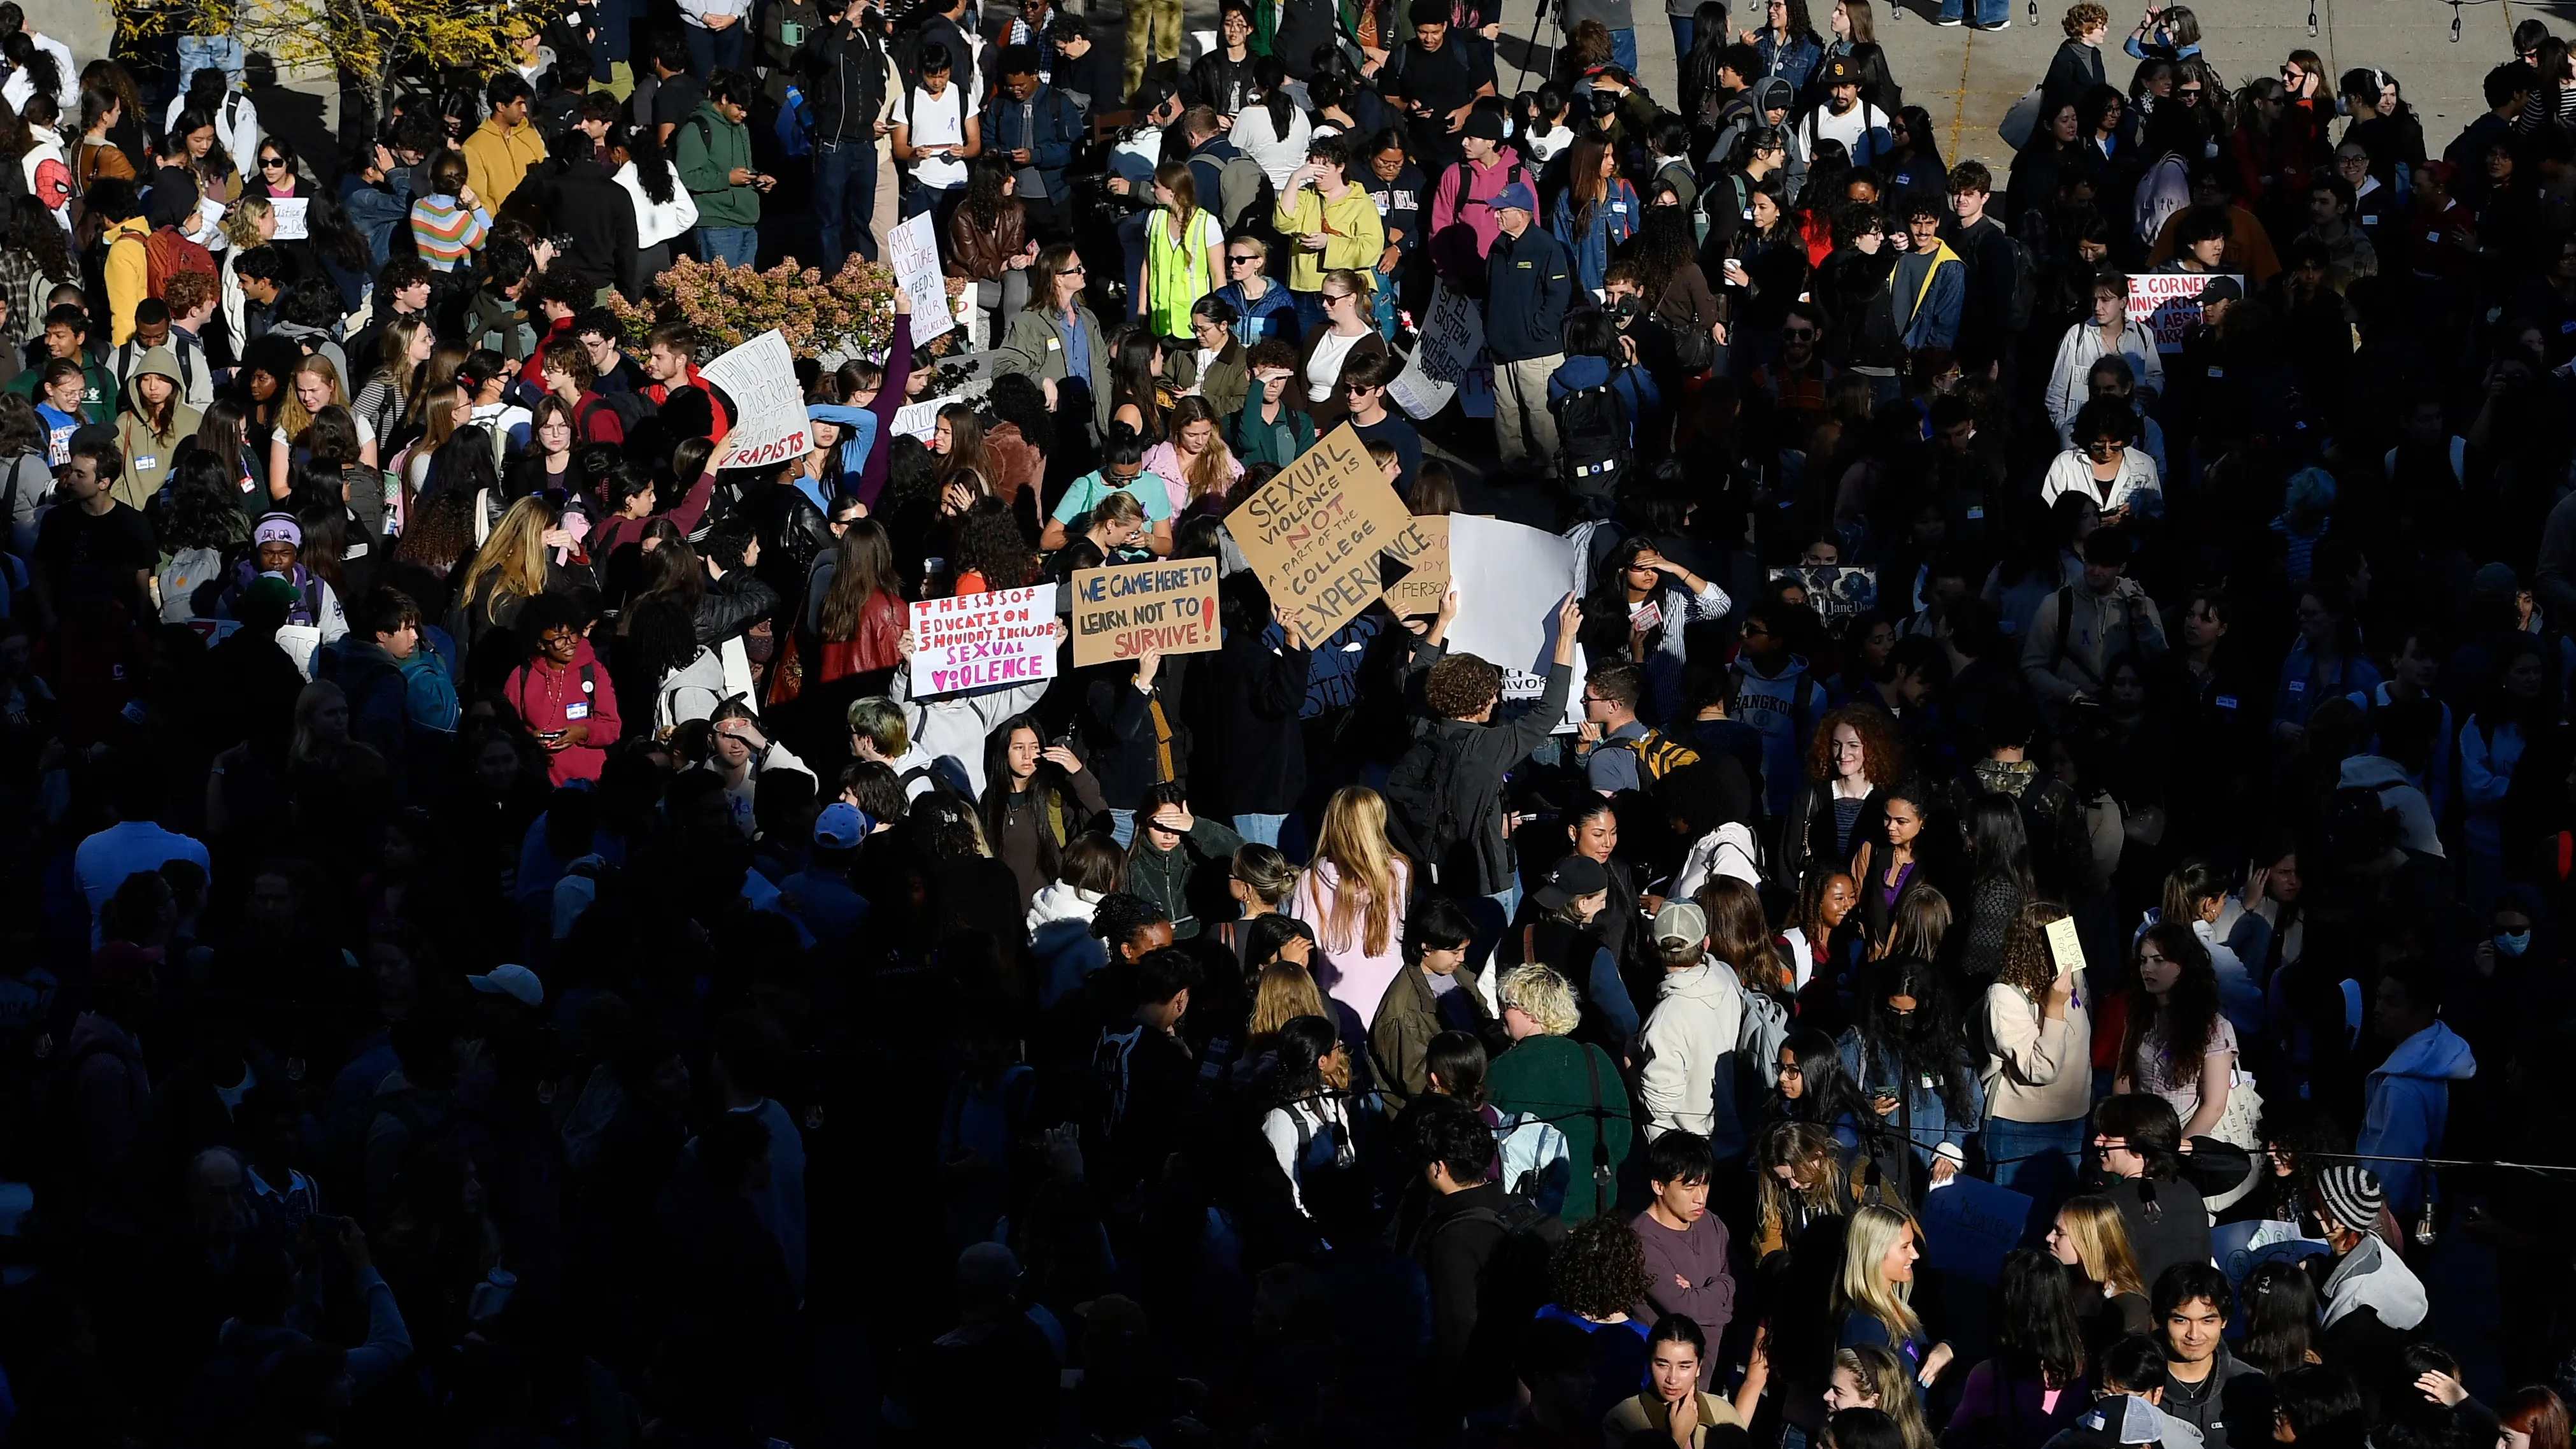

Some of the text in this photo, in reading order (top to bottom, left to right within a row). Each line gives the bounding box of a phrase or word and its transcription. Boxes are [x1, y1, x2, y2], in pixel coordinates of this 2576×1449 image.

[889, 222, 918, 257] RAPE
[894, 246, 934, 278] CULTURE
[911, 271, 934, 297] FEEDS
[918, 292, 927, 304] ON
[2148, 276, 2206, 294] CORNEL
[911, 300, 941, 325] YOUR
[1454, 296, 1469, 323] EL
[913, 315, 951, 344] COMPLACENCY
[1434, 304, 1472, 350] SISTEMA
[1439, 332, 1451, 348] ES
[703, 338, 786, 392] THINGS THAT
[737, 374, 792, 420] CAUSE RAPE
[733, 431, 804, 465] RAPISTS
[1248, 443, 1351, 528] SEXUAL
[1259, 457, 1360, 545] VIOLENCE IS
[1286, 492, 1344, 551] NOT
[1268, 510, 1358, 587] A PART OF THE
[1078, 566, 1212, 605] WE CAME HERE TO
[1402, 581, 1448, 599] PERSO
[915, 596, 967, 616] THE
[1080, 597, 1199, 635] LEARN, NOT TO
[1828, 601, 1852, 616] Jane
[920, 608, 1028, 634] EDUCATION
[946, 641, 1024, 665] SEXUAL
[2061, 920, 2074, 938] NO
[2056, 937, 2067, 955] FOR
